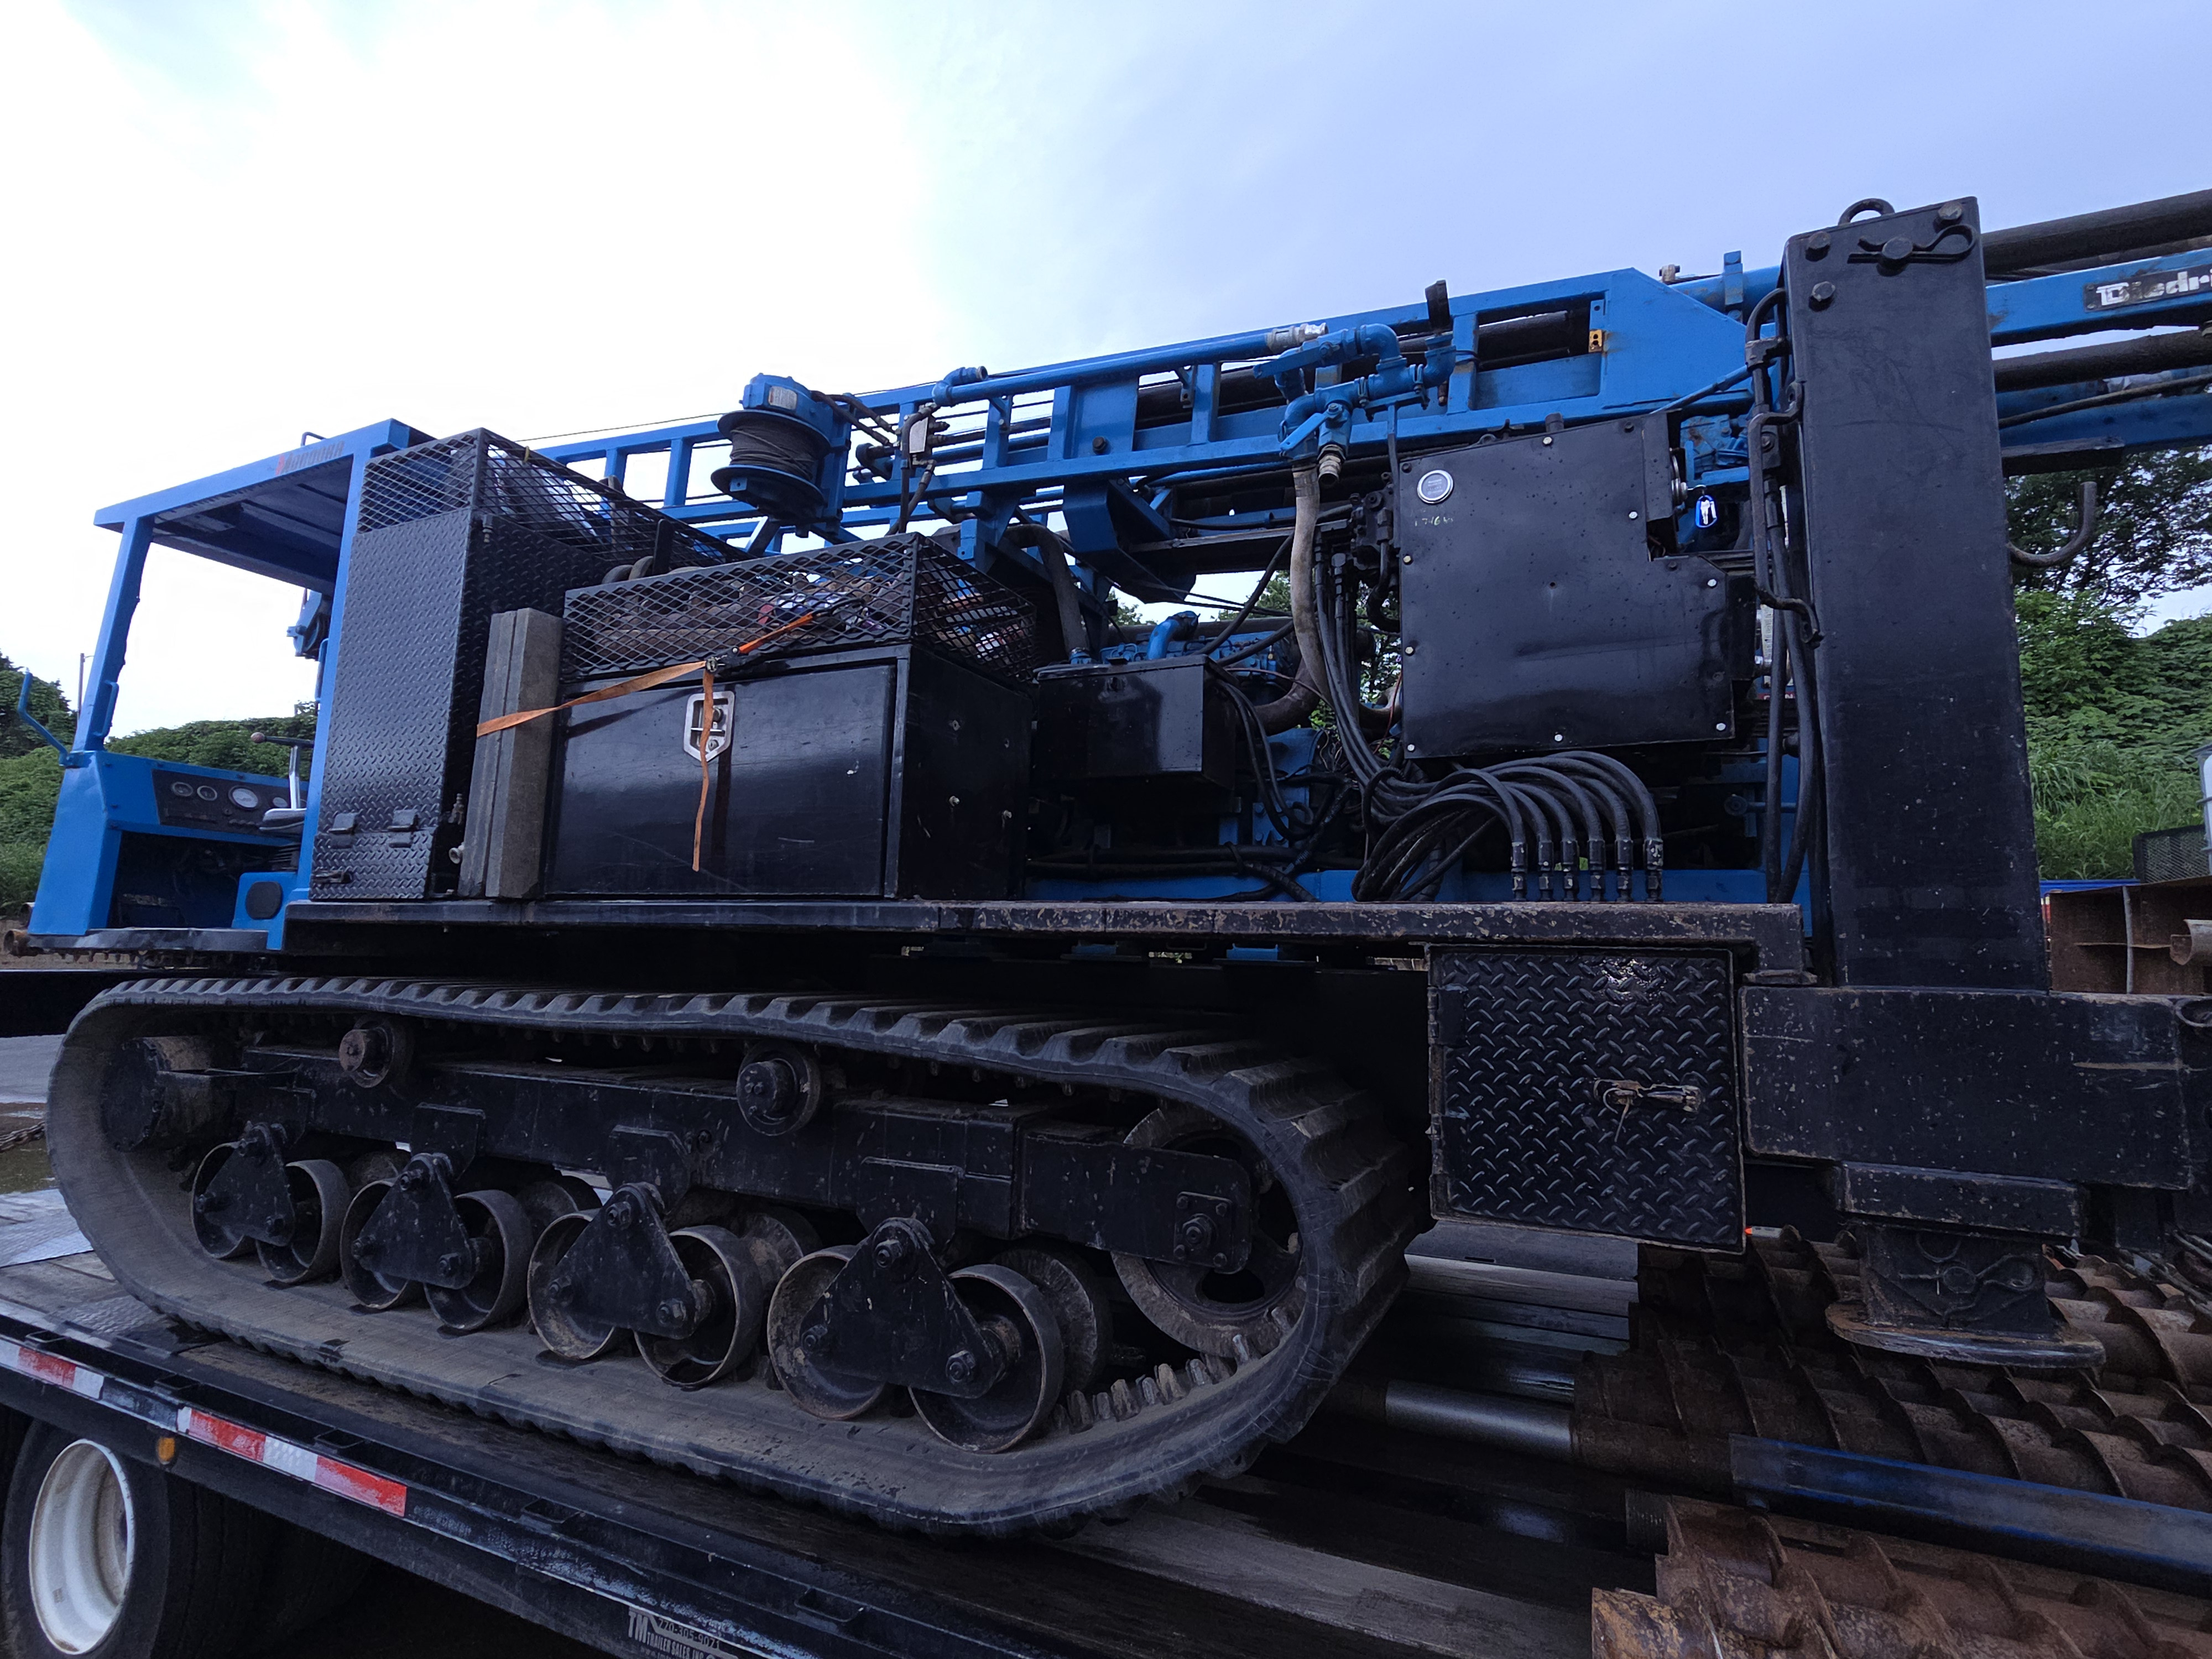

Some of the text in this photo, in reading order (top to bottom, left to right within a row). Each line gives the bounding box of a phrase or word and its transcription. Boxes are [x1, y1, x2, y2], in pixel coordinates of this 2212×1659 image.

[2096, 268, 2212, 306] Diedr
[628, 1611, 648, 1644] TM
[646, 1631, 671, 1653] TRAILER
[658, 1618, 720, 1650] 770-305-9071
